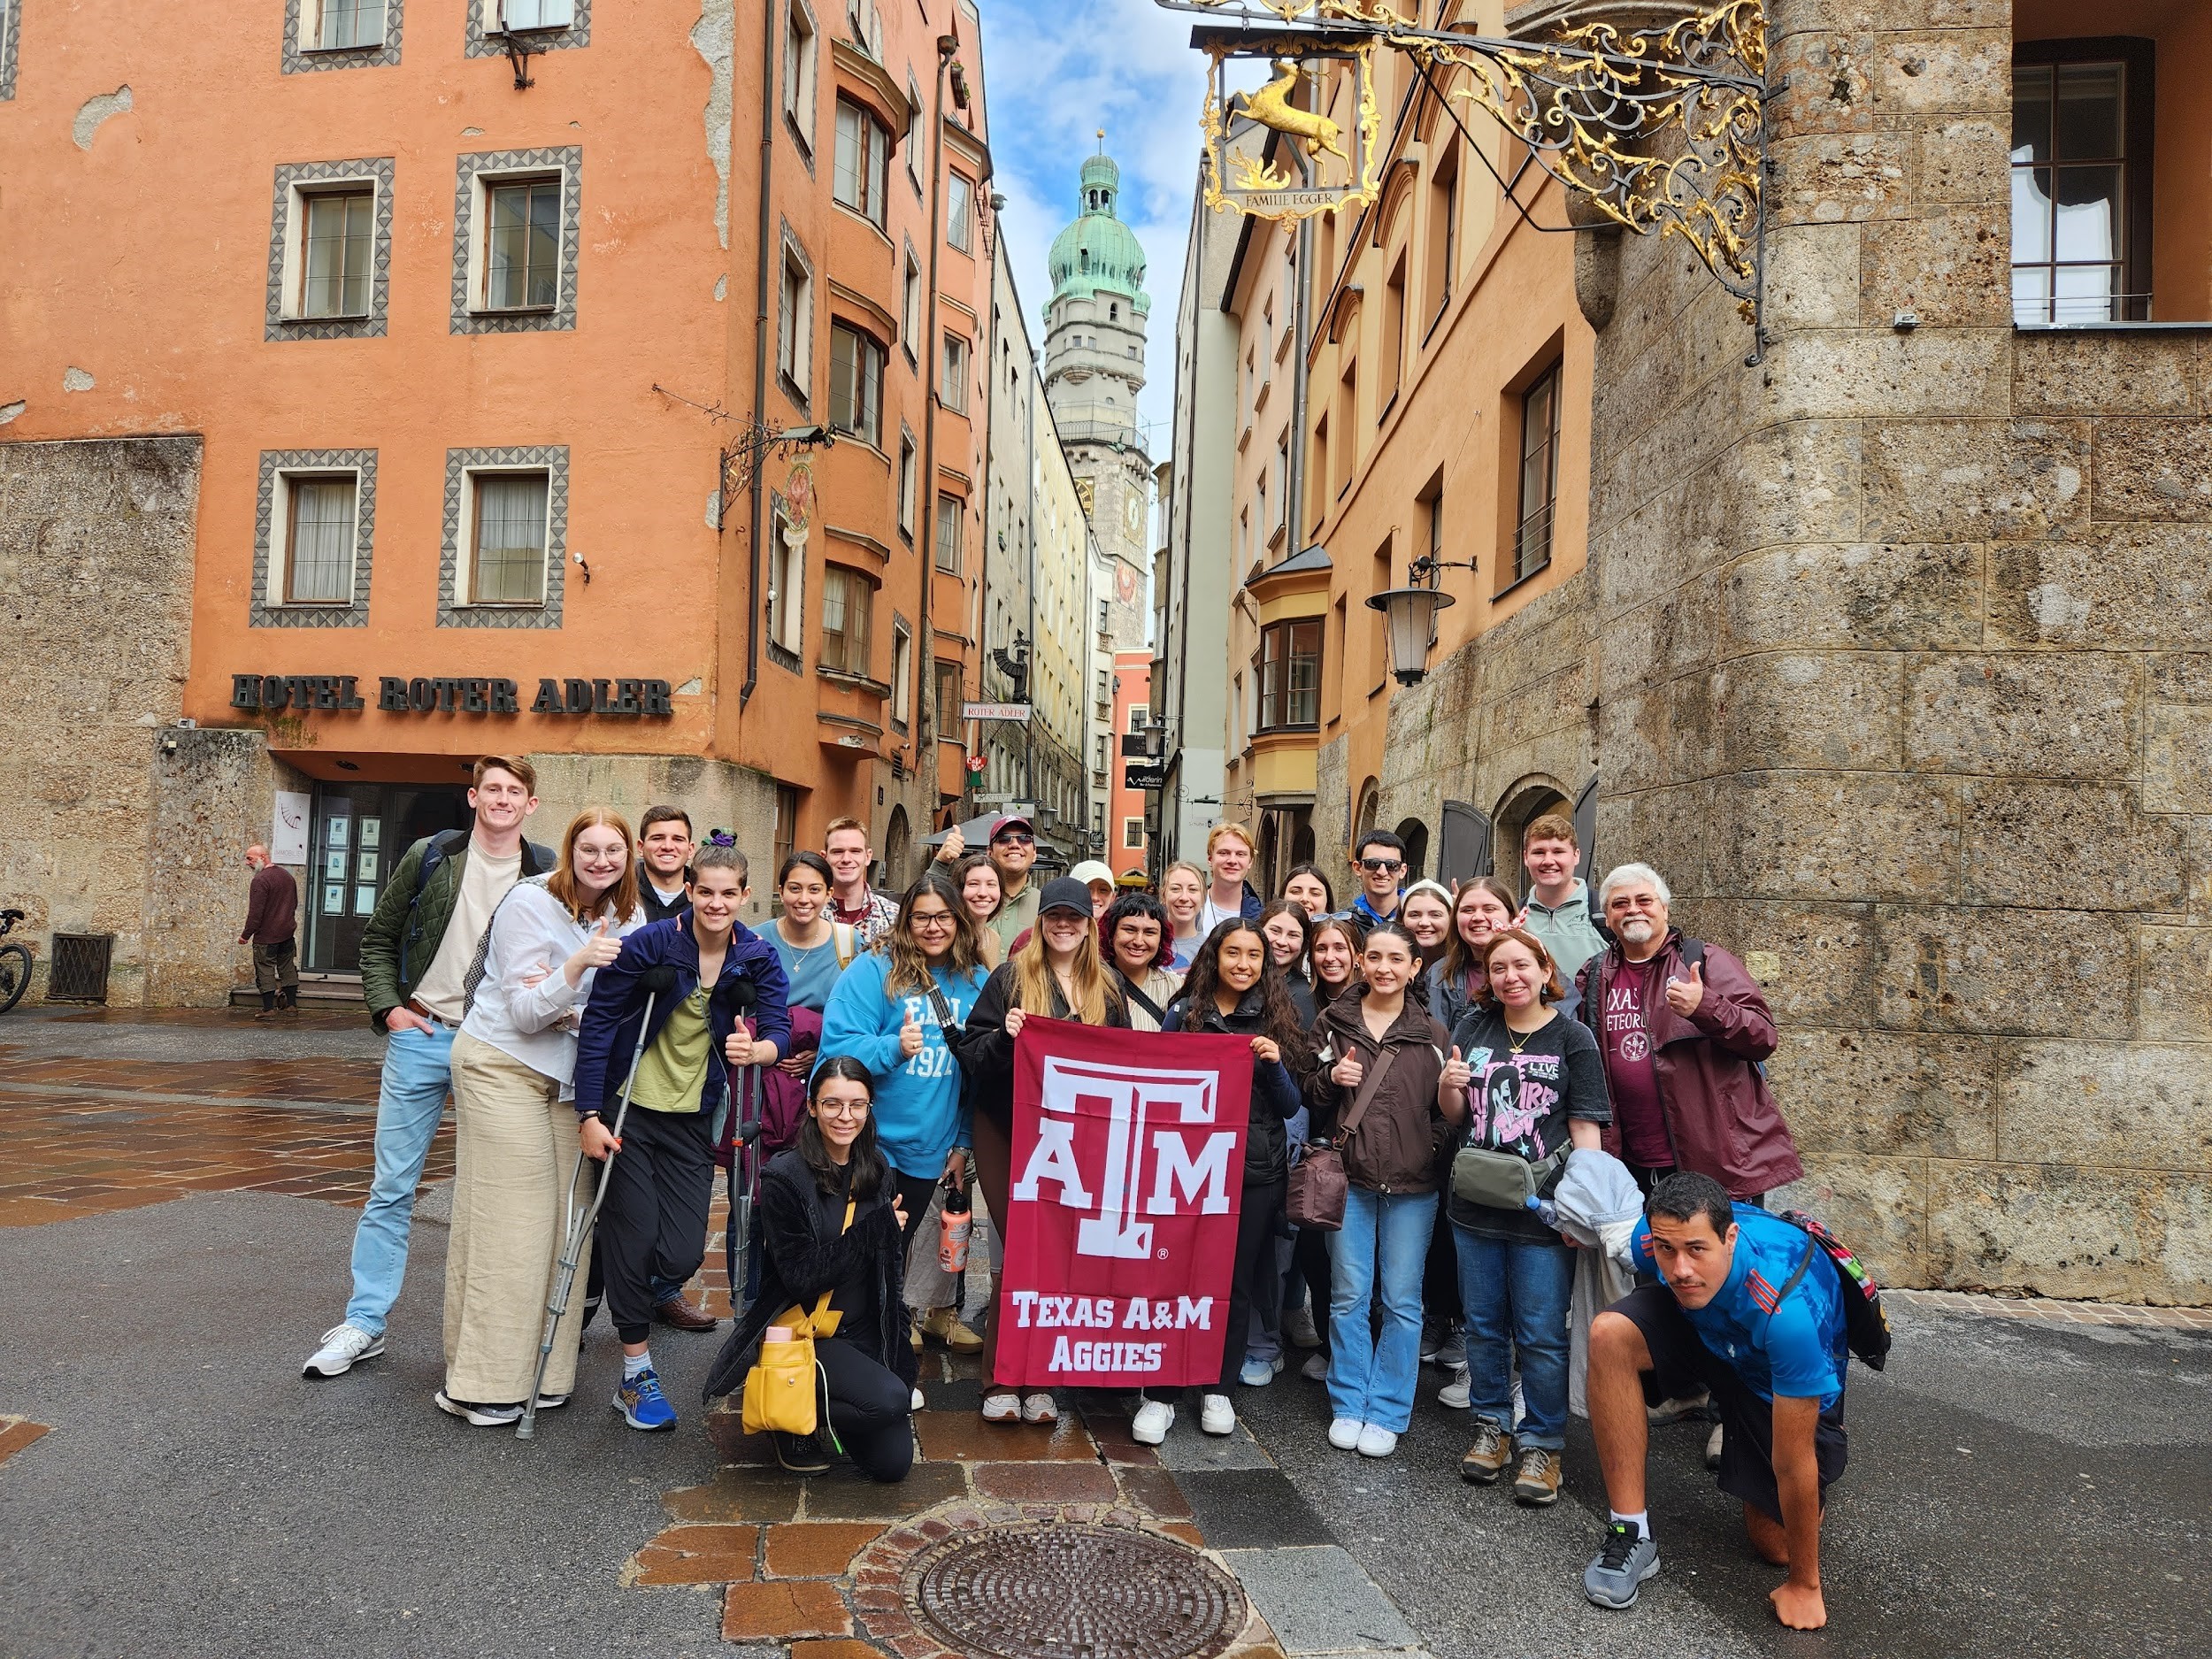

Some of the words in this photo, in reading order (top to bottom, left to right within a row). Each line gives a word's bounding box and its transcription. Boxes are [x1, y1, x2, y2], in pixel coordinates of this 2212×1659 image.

[1246, 194, 1289, 207] FAMILIE
[1293, 192, 1333, 204] EGGER
[230, 674, 365, 710] HOTEL
[377, 676, 520, 713] ROTER
[530, 678, 674, 715] ADLER
[968, 708, 995, 717] ROTER
[999, 709, 1025, 718] ADLER
[1530, 1062, 1559, 1075] LIVE
[1122, 1295, 1214, 1331] A&M
